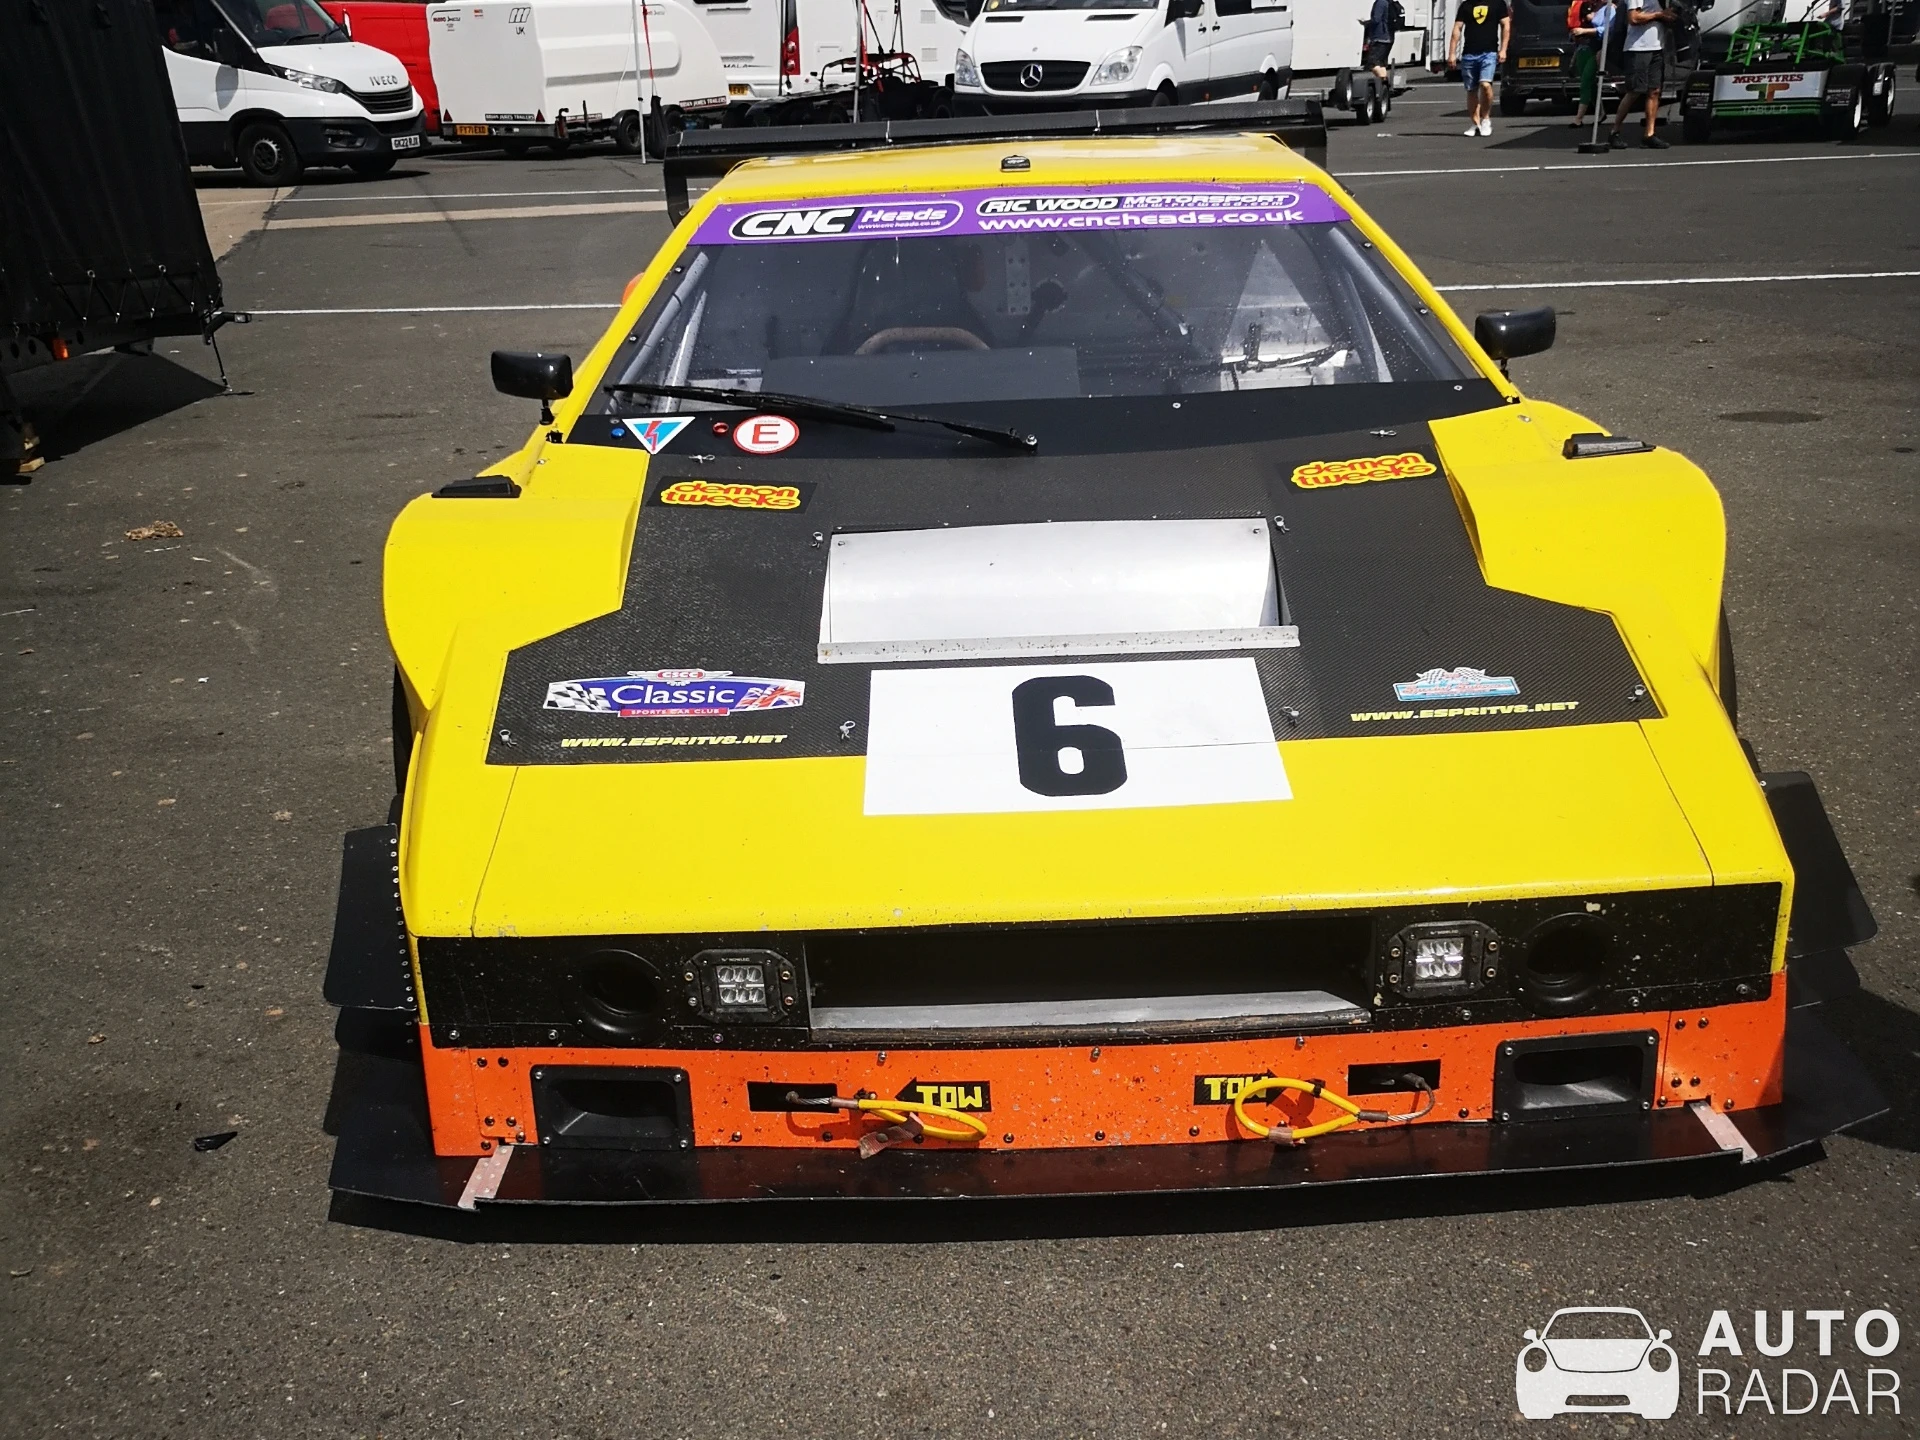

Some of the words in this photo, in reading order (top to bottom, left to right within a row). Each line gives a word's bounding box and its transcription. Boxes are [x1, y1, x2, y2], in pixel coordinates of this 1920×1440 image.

[515, 26, 526, 35] UK
[369, 74, 398, 86] IVECO
[1732, 75, 1766, 84] MRF
[1767, 74, 1804, 83] TYRES
[985, 199, 1031, 213] RIC
[1036, 197, 1119, 211] WOOD
[1123, 195, 1289, 206] MOTORSPORT
[741, 208, 855, 236] CNC
[861, 208, 948, 223] Heads
[978, 210, 1305, 230] www.cncheads.co.uk
[752, 423, 780, 444] E
[1300, 455, 1421, 475] demon
[1298, 464, 1433, 486] tweeks
[665, 490, 797, 507] tweeks
[674, 482, 796, 498] demon
[661, 671, 698, 679] CSCC
[611, 685, 736, 704] Classic
[1350, 701, 1579, 722] WWW.ESPRITV8.NET
[560, 734, 788, 748] WWW.ESPRITV8.NET
[1012, 675, 1128, 797] 6
[916, 1085, 983, 1109] TOW
